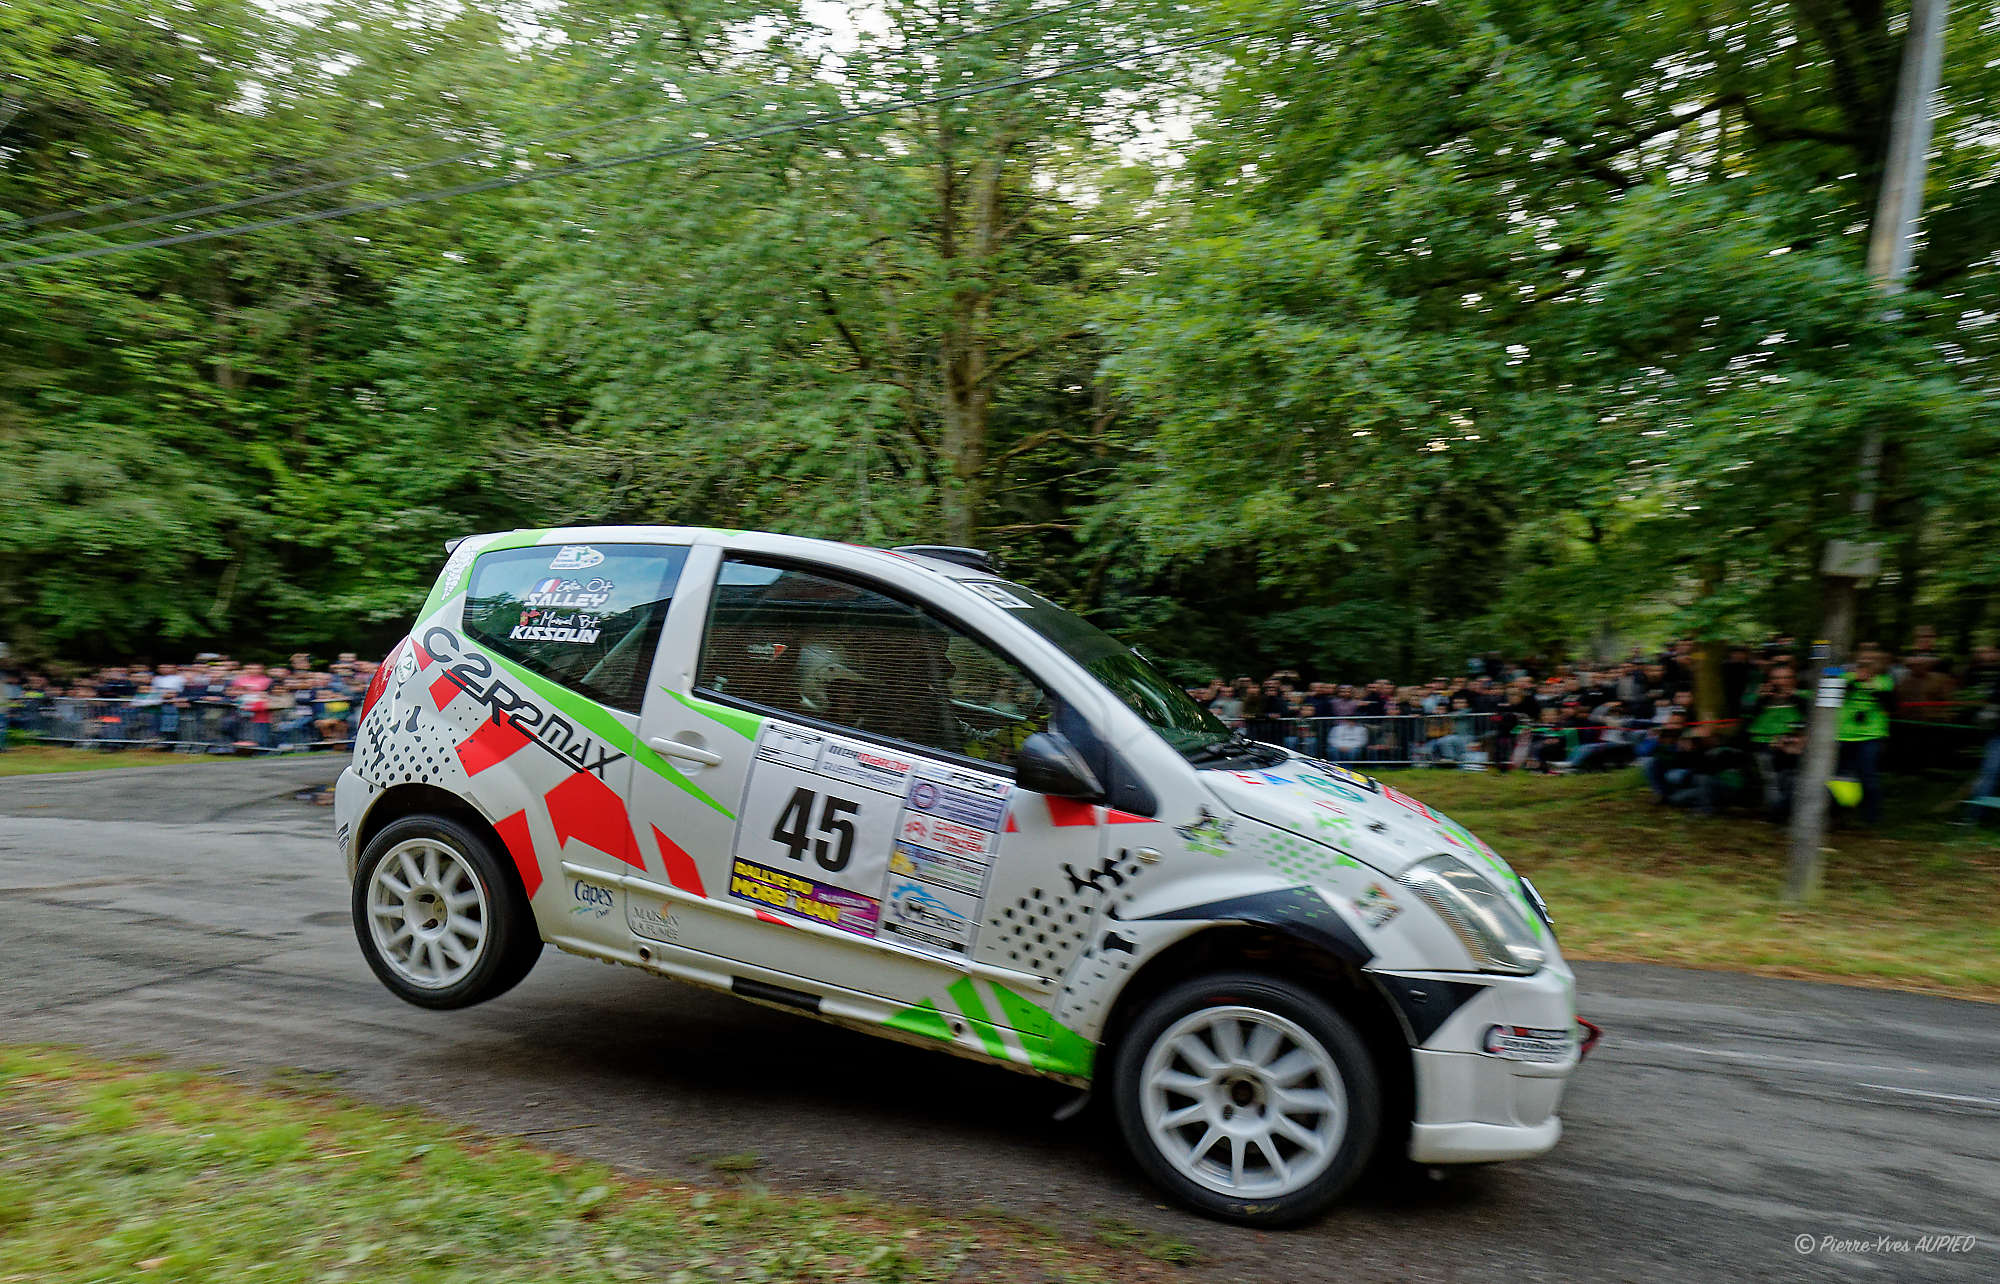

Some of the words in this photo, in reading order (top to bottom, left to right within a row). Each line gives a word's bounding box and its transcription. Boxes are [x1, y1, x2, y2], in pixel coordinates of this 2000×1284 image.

[523, 593, 609, 608] SALLEY
[509, 625, 601, 643] KISSOUN
[770, 786, 862, 872] 45
